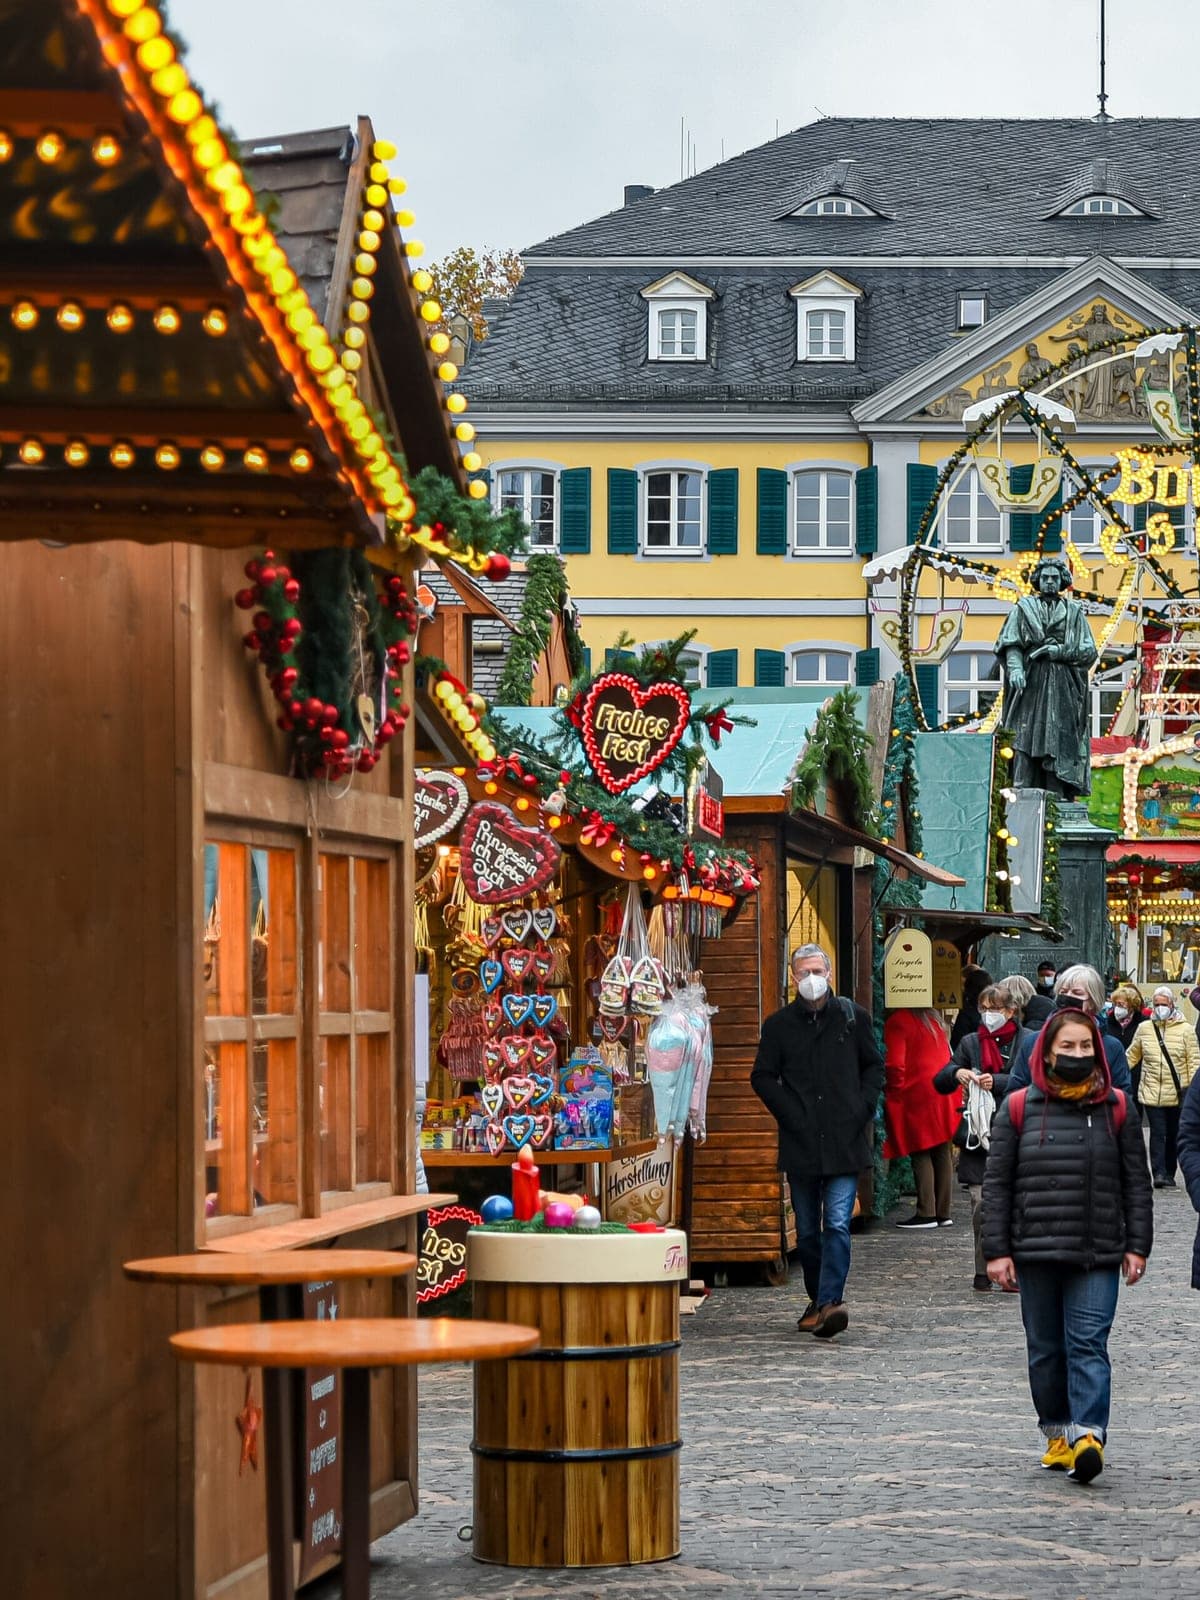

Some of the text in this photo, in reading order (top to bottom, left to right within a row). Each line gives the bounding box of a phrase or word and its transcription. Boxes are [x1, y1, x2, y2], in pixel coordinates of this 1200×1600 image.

[596, 703, 670, 740] Frohes
[602, 733, 650, 765] Fest
[414, 788, 447, 815] denke
[471, 838, 525, 886] ich liebe
[476, 820, 537, 880] Prinzessin
[473, 858, 504, 889] Dich
[608, 1158, 672, 1200] Herstellung
[310, 1436, 337, 1475] KAFFEE
